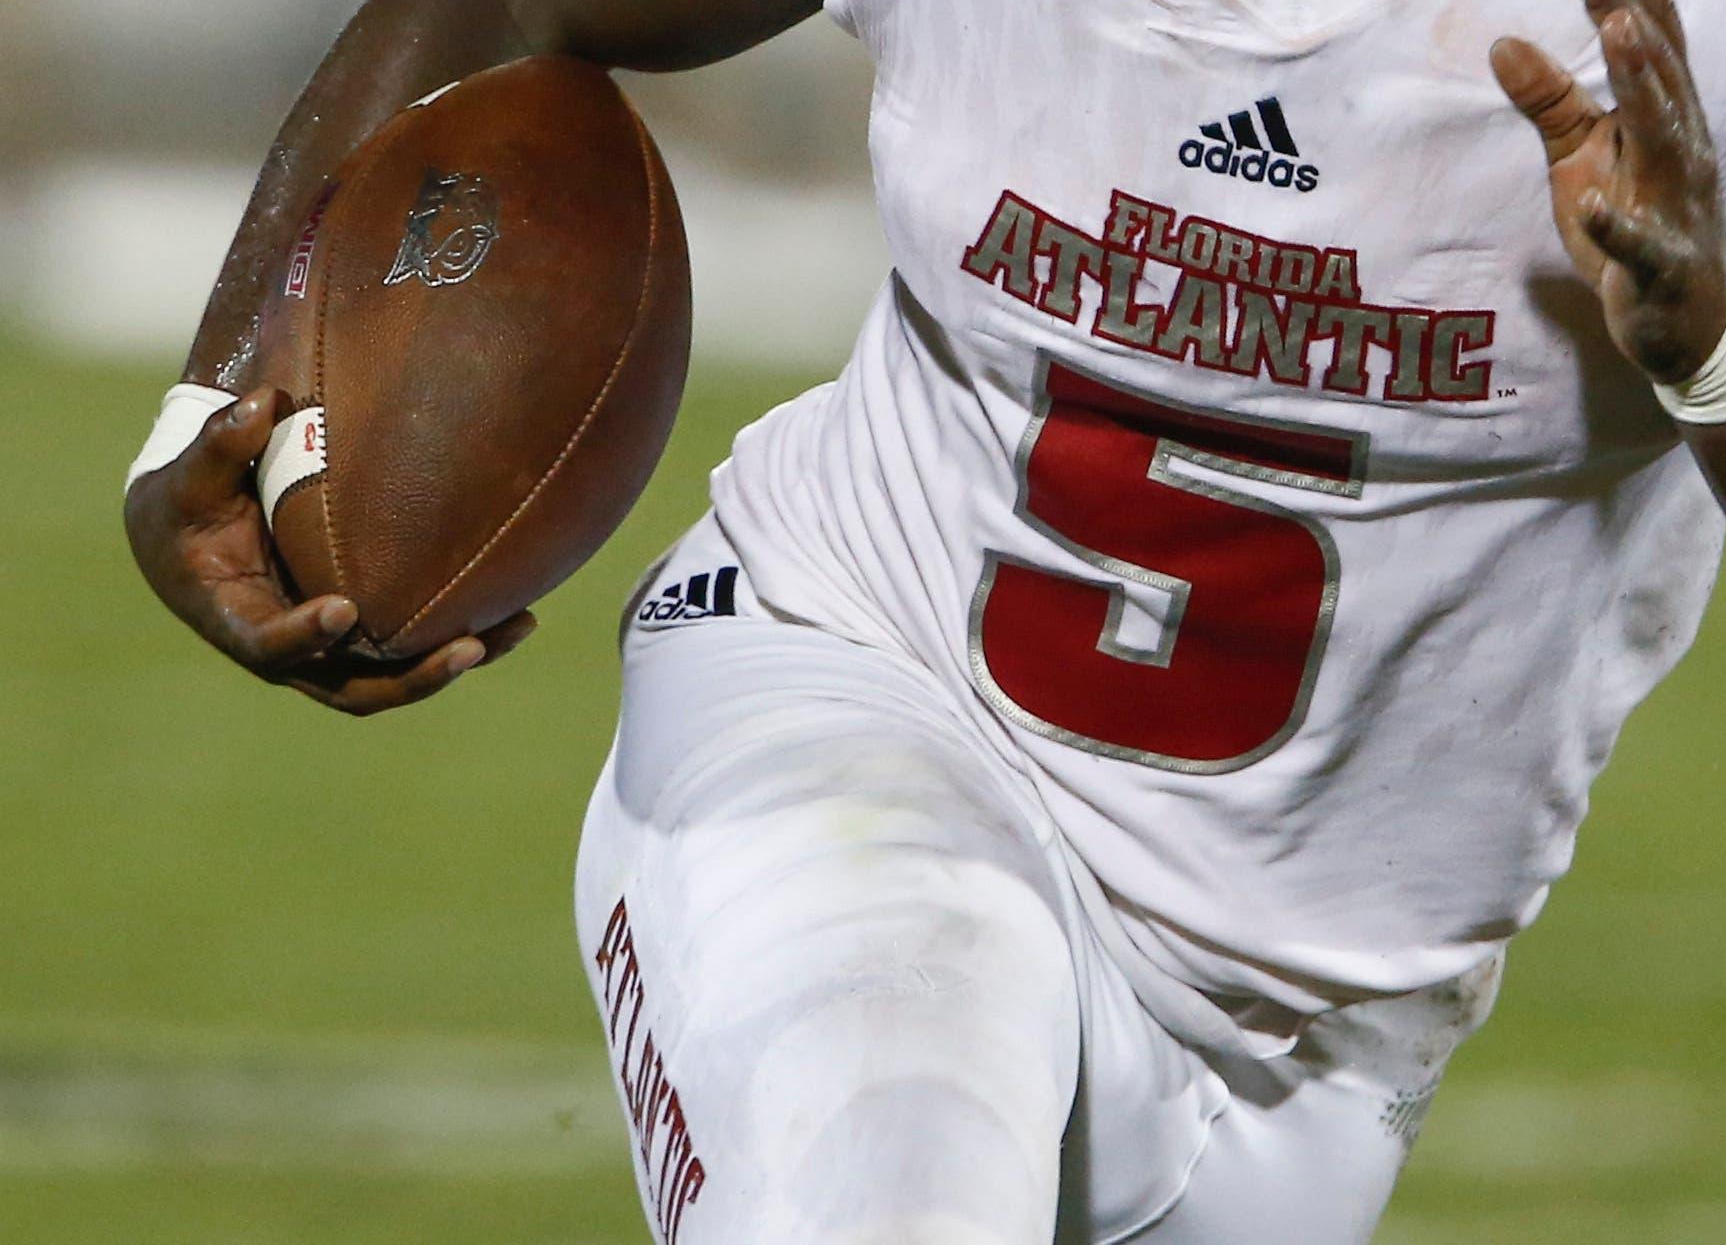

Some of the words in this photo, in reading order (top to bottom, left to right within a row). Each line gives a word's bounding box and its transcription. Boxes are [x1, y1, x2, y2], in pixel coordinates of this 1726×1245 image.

[1109, 187, 1362, 302] FLORIDA
[1178, 138, 1320, 193] adidas
[960, 188, 1496, 402] ATLANTIC
[967, 346, 1371, 776] 5
